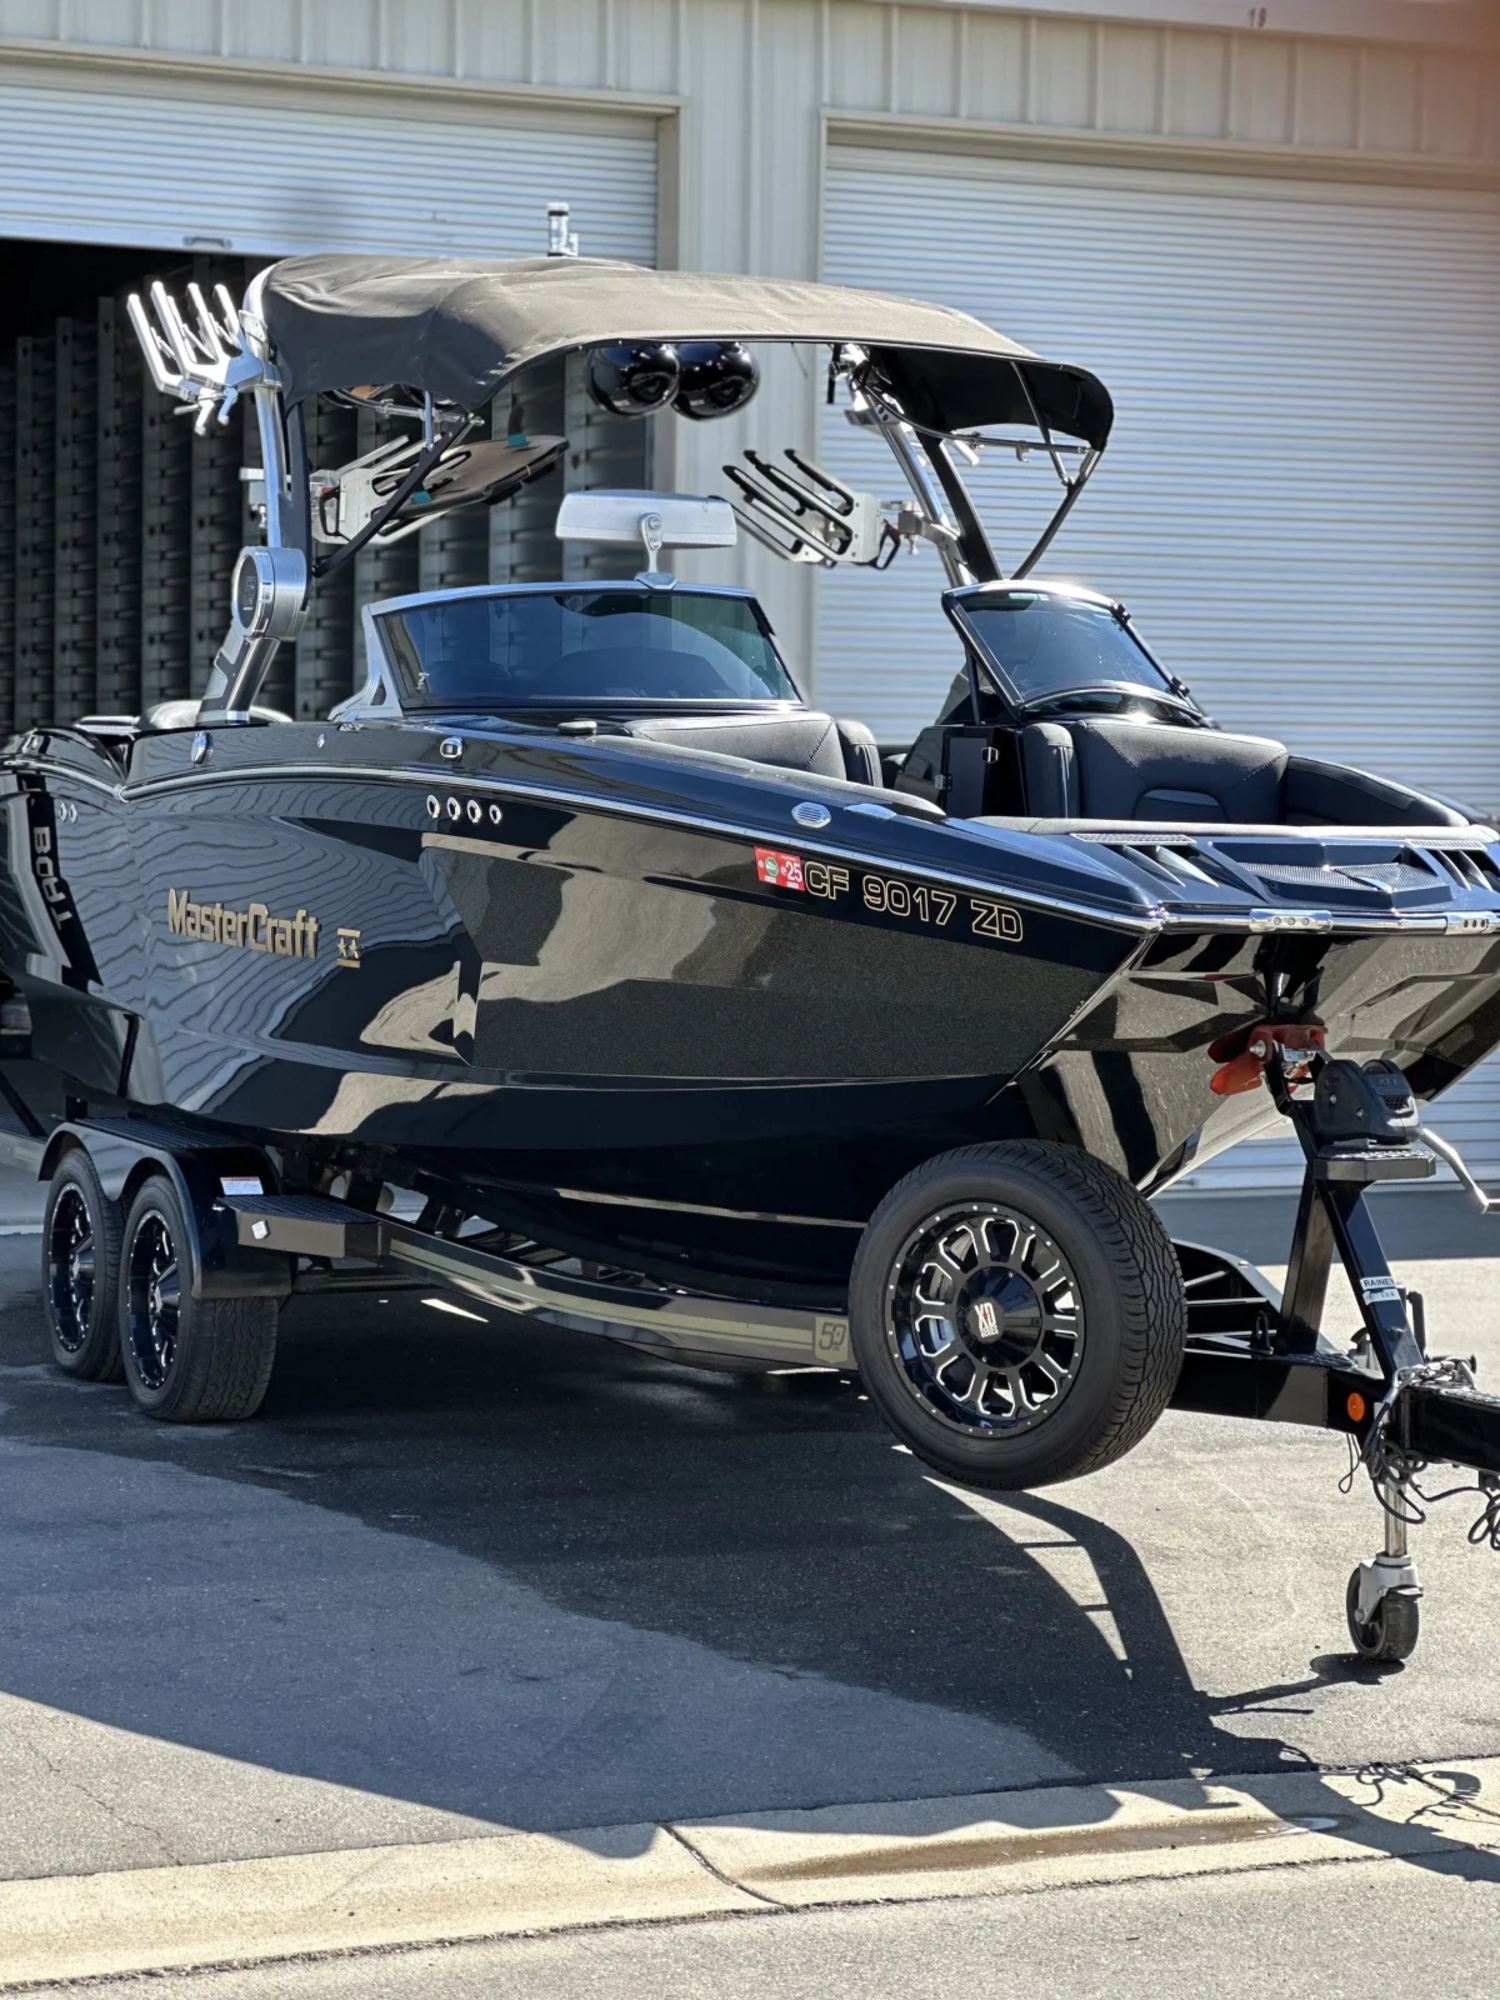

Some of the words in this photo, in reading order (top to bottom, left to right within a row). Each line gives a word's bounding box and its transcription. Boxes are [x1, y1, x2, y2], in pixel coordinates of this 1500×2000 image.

[785, 860, 803, 883] 25
[804, 861, 849, 900] CF
[862, 874, 957, 926] 9017
[970, 899, 1023, 942] ZD
[167, 887, 322, 960] MasterCraft
